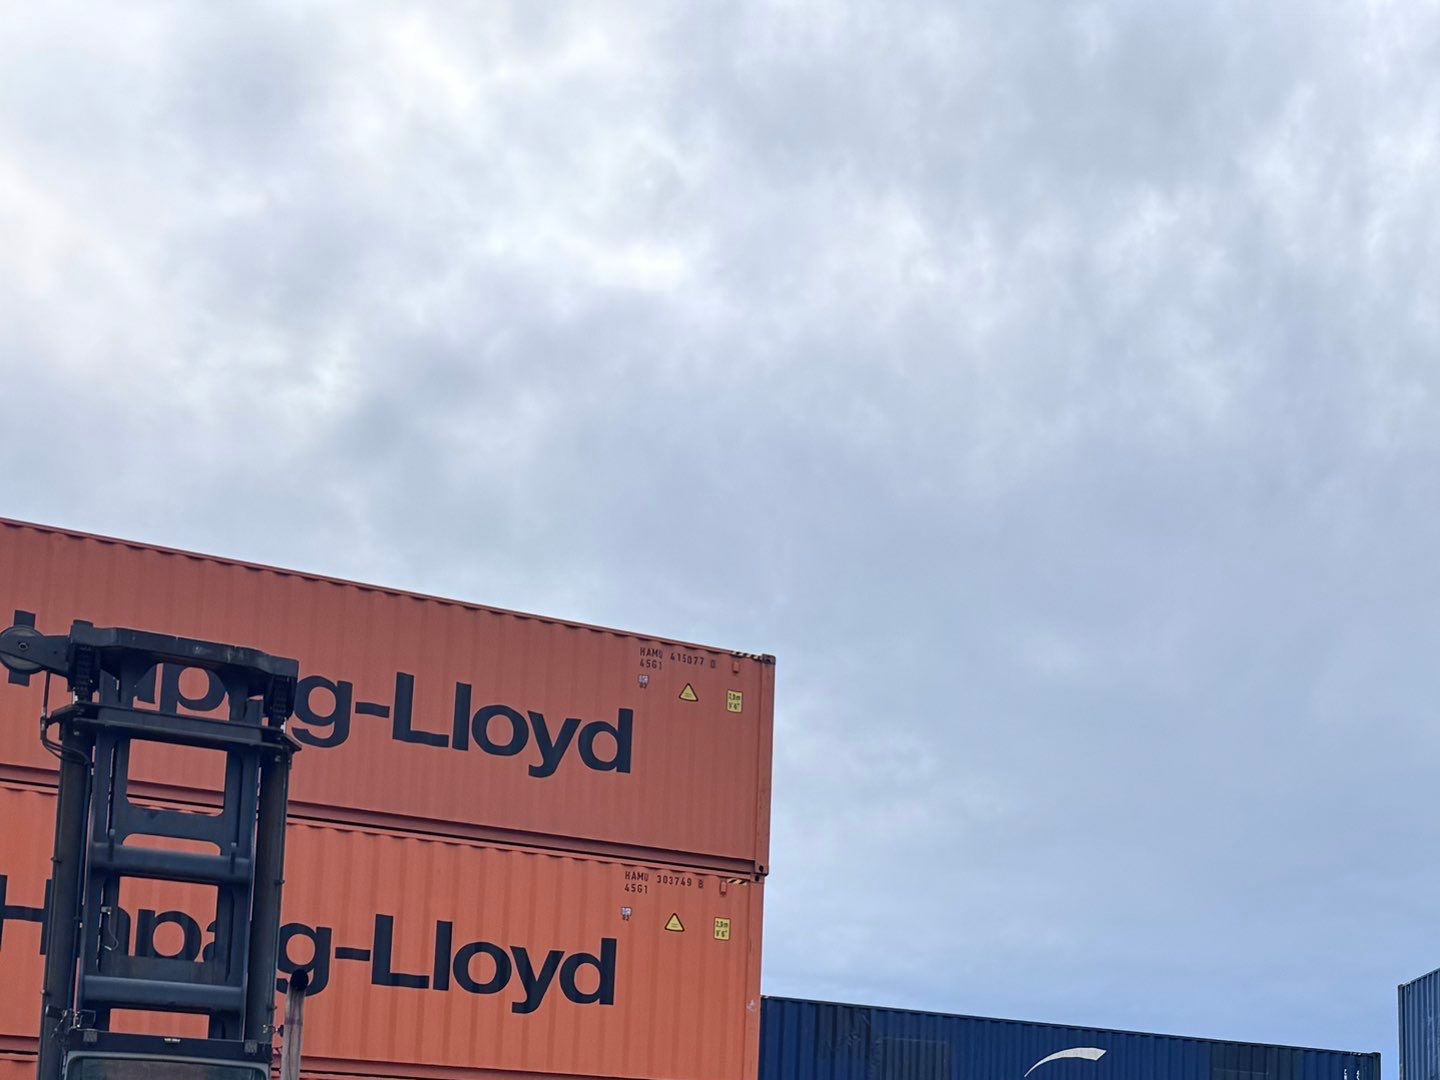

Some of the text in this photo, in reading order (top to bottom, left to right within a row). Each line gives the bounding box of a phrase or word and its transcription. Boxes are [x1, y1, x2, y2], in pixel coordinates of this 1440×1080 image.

[639, 647, 663, 659] HAMU
[624, 871, 649, 881] HAMU
[624, 883, 648, 894] 45G1
